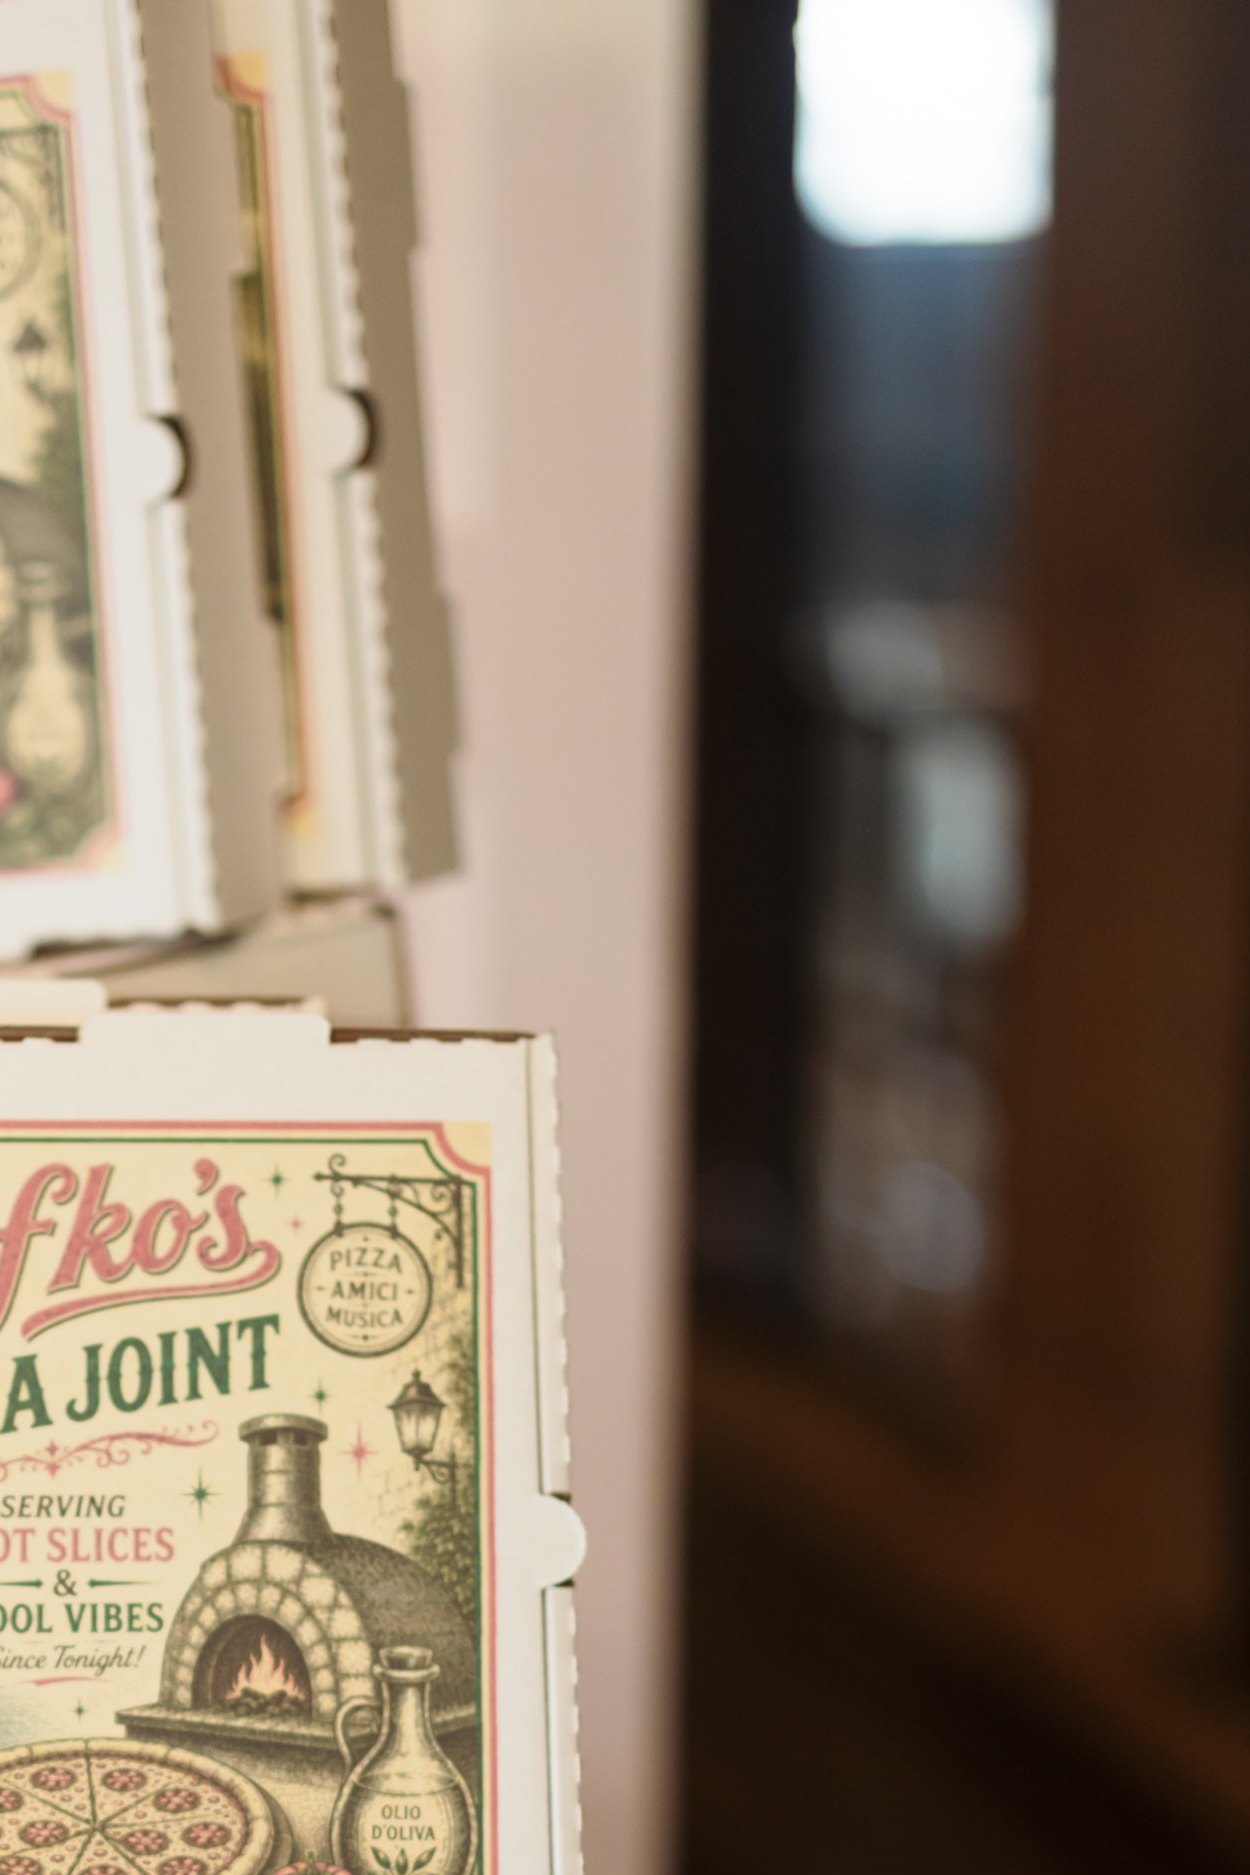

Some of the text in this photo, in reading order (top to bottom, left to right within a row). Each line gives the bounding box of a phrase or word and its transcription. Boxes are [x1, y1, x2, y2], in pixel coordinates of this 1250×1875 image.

[330, 1248, 402, 1275] PIZZA
[330, 1280, 398, 1301] AMICI
[325, 1304, 404, 1328] MUSICA
[65, 1313, 281, 1422] JOINT
[0, 1494, 126, 1519] SERVING
[46, 1526, 175, 1564] SLICES
[52, 1568, 78, 1597] &
[64, 1602, 164, 1633] VIBES
[52, 1644, 147, 1677] Tonight!
[381, 1804, 421, 1820] OLIO
[371, 1824, 435, 1841] D'OLIVA
